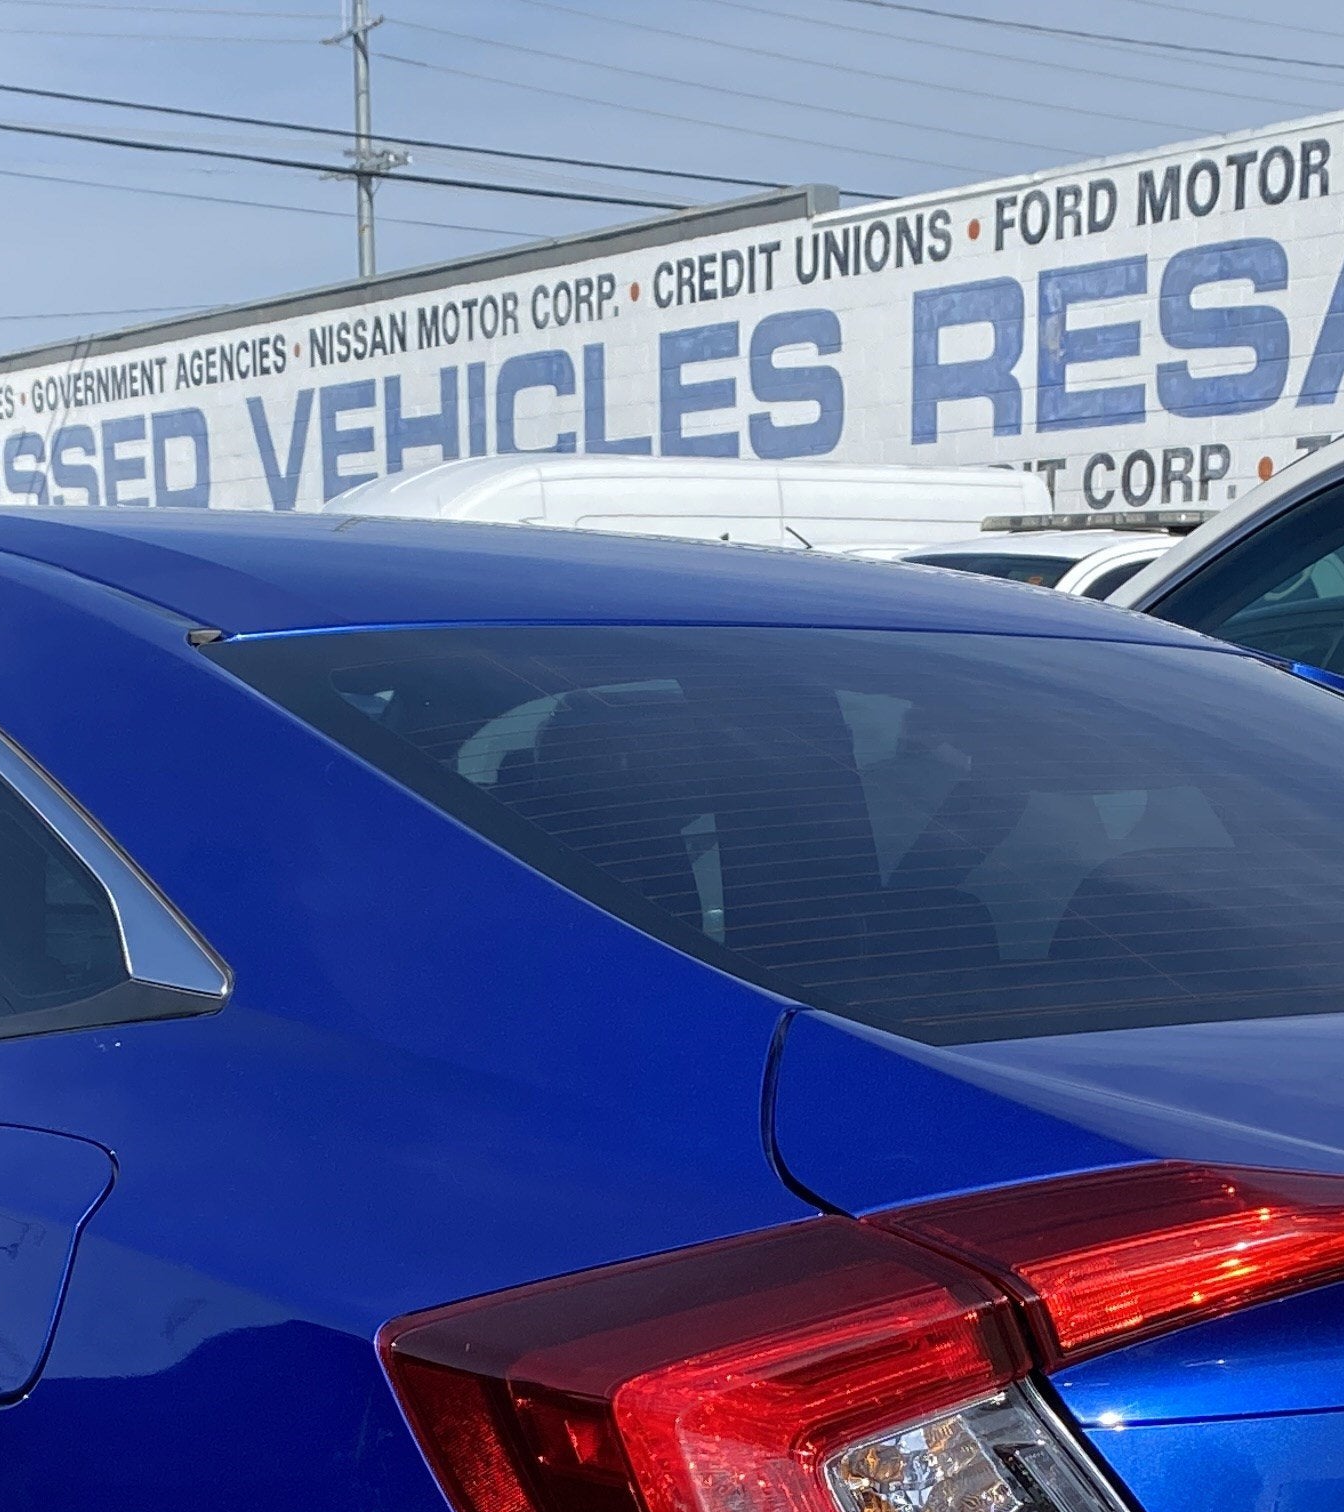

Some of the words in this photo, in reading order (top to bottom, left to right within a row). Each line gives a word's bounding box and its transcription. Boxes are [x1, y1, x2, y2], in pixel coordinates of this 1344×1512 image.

[31, 356, 167, 413] GOVERNMENT
[174, 333, 287, 390] AGENCIES
[309, 311, 407, 367] NISSAN
[418, 290, 519, 350] MOTOR
[531, 272, 620, 331] CORP.
[653, 241, 782, 309] CREDIT
[794, 209, 953, 285] UNIONS
[994, 177, 1119, 252] FORD
[1136, 137, 1331, 227] MOTOR
[245, 307, 846, 511] VEHICLES
[1082, 443, 1238, 510] CORP.
